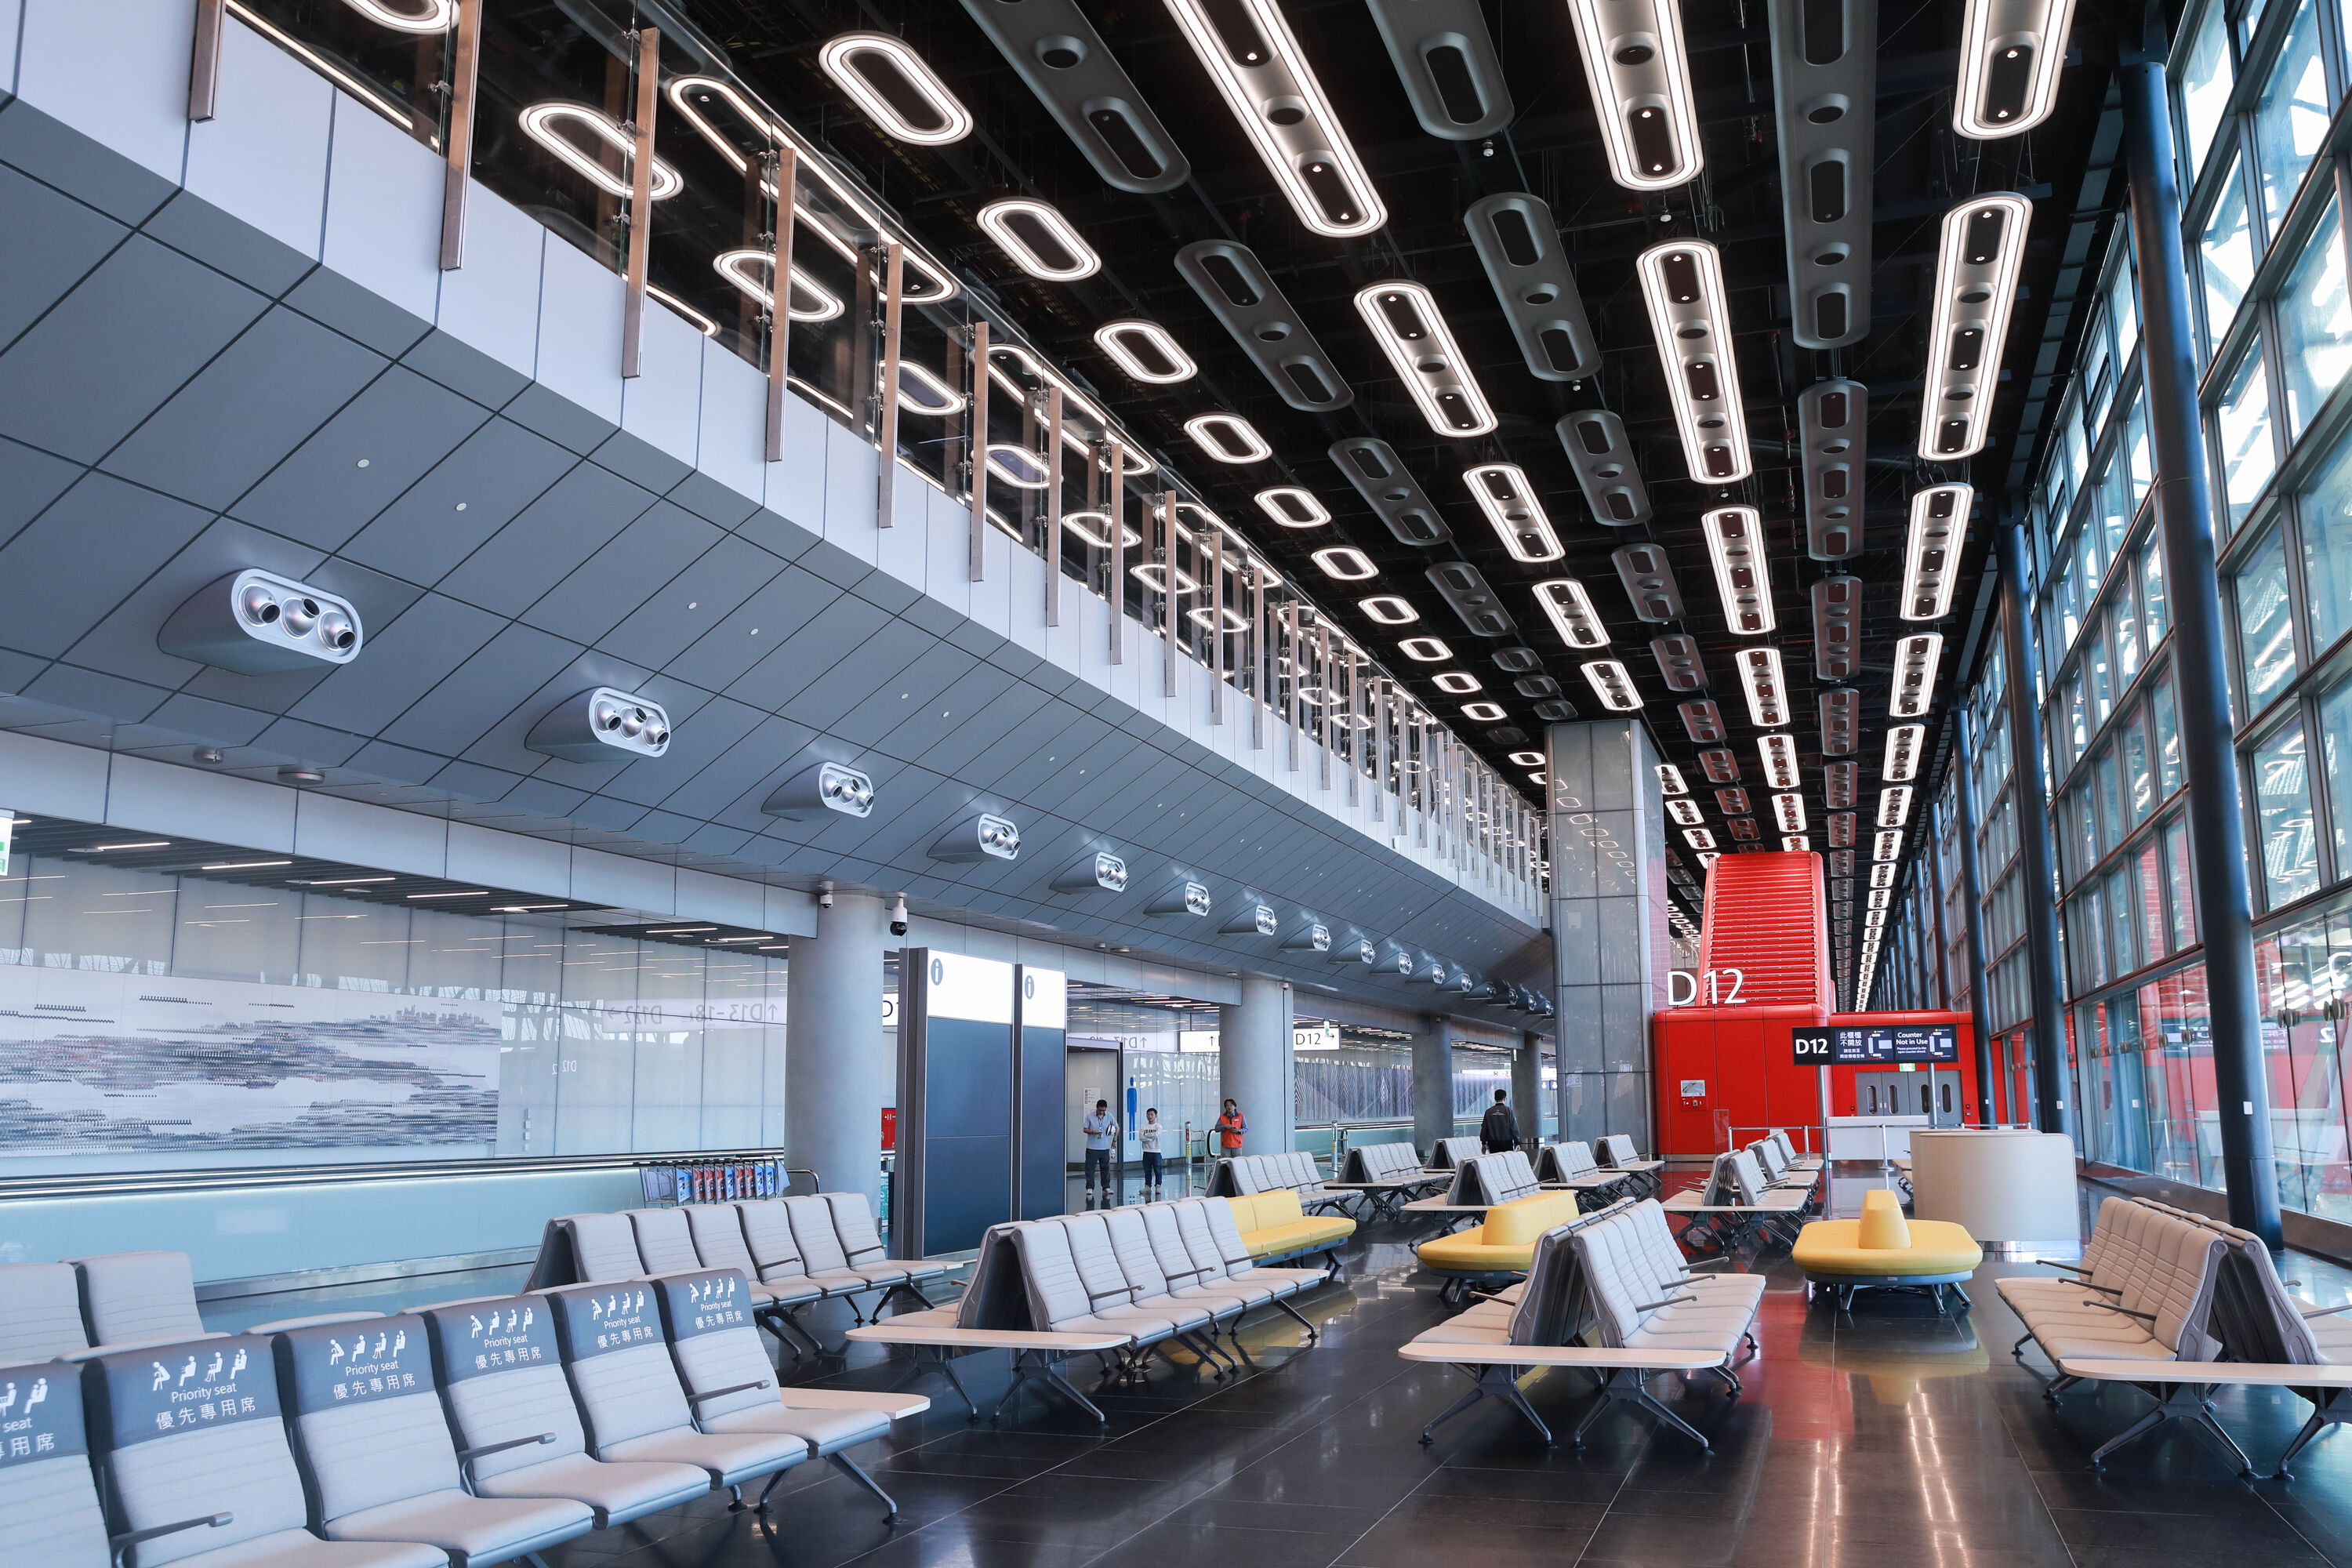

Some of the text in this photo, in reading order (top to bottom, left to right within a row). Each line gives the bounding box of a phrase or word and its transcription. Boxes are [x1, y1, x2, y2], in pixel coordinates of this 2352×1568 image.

[1667, 968, 1747, 1007] D12
[1296, 1033, 1321, 1045] D12
[1795, 1038, 1828, 1054] D12
[700, 1299, 732, 1312] Priority seat
[604, 1315, 641, 1330] Priority seat
[695, 1310, 743, 1330] 優先專用席
[484, 1334, 528, 1348] Priority seat
[597, 1326, 653, 1348] 優先專用席
[475, 1346, 542, 1370] 優先專用席
[345, 1359, 399, 1377] Priority seat
[171, 1382, 238, 1403] Priority seat
[333, 1373, 416, 1400] 優先專用席
[156, 1396, 257, 1431] 優先專用席
[3, 1417, 33, 1433] seat
